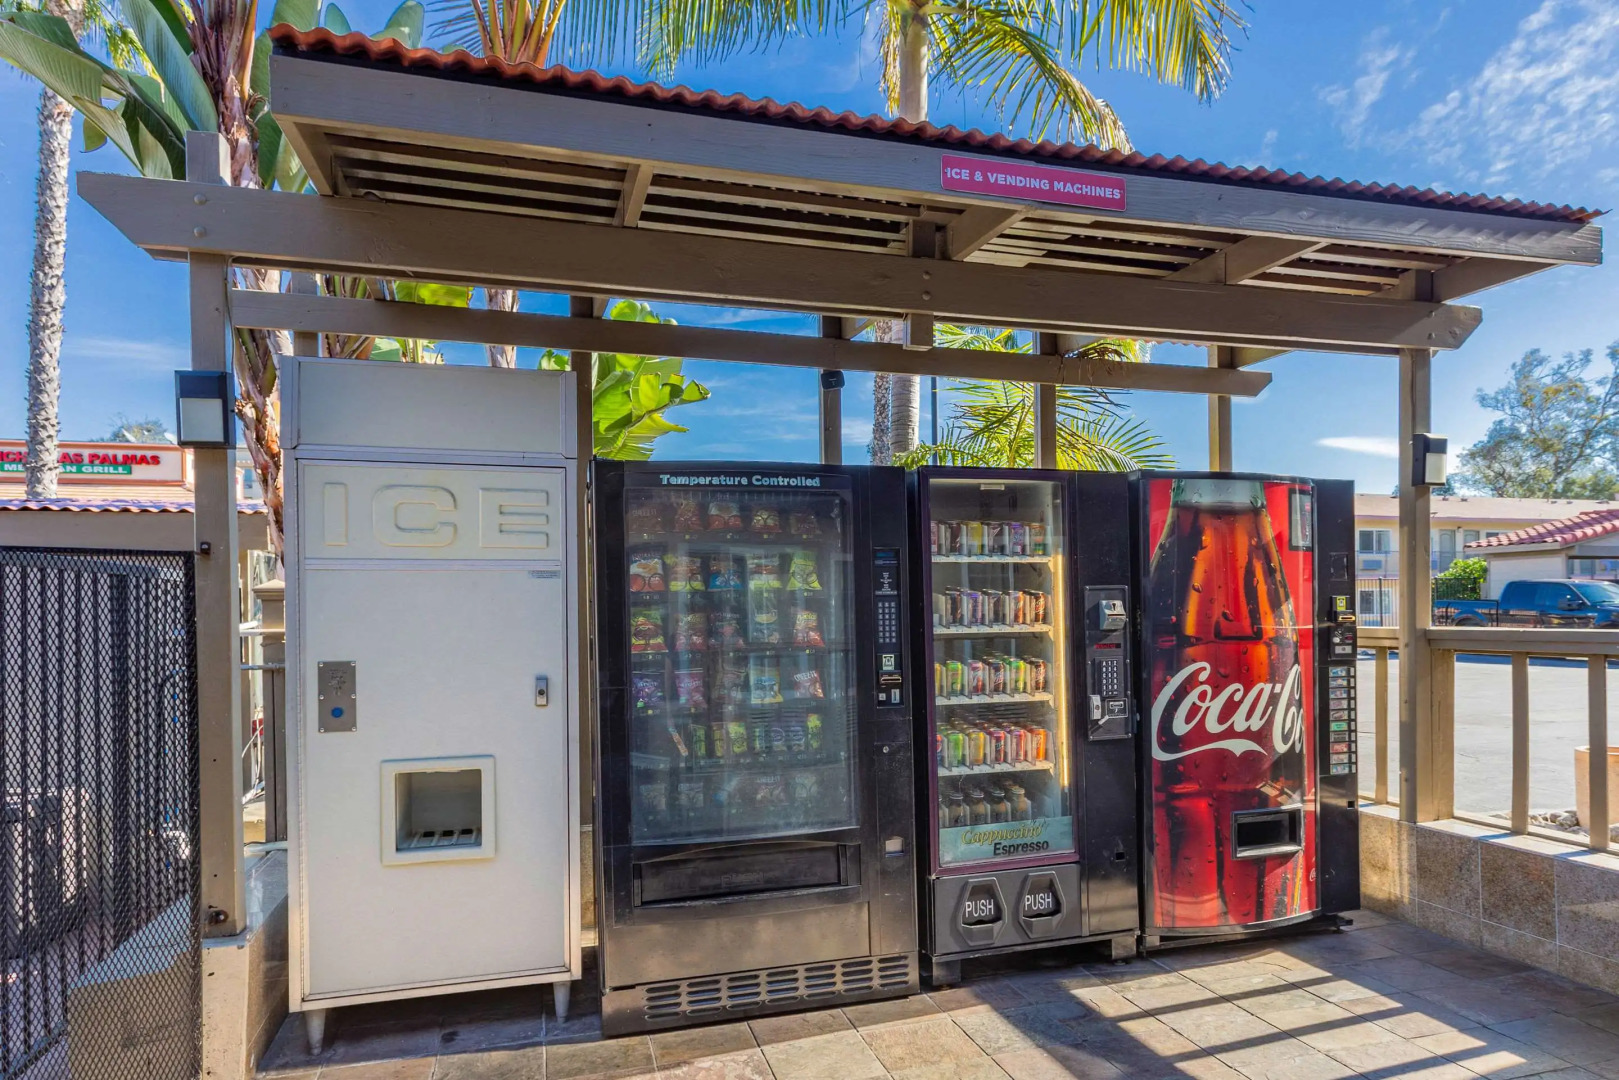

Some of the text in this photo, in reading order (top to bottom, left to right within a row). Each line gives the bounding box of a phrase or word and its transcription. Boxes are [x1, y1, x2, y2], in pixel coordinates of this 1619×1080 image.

[945, 167, 1121, 199] ICE & VENDING MACHINES
[0, 451, 161, 466] CH AS PALMAS
[81, 465, 128, 474] GRILL
[659, 474, 821, 487] Temperature Controlled
[323, 482, 549, 548] ICE
[961, 824, 1043, 846] Cappuccino
[993, 839, 1050, 856] Espresso
[965, 899, 994, 917] PUSH
[1024, 892, 1053, 910] PUSH
